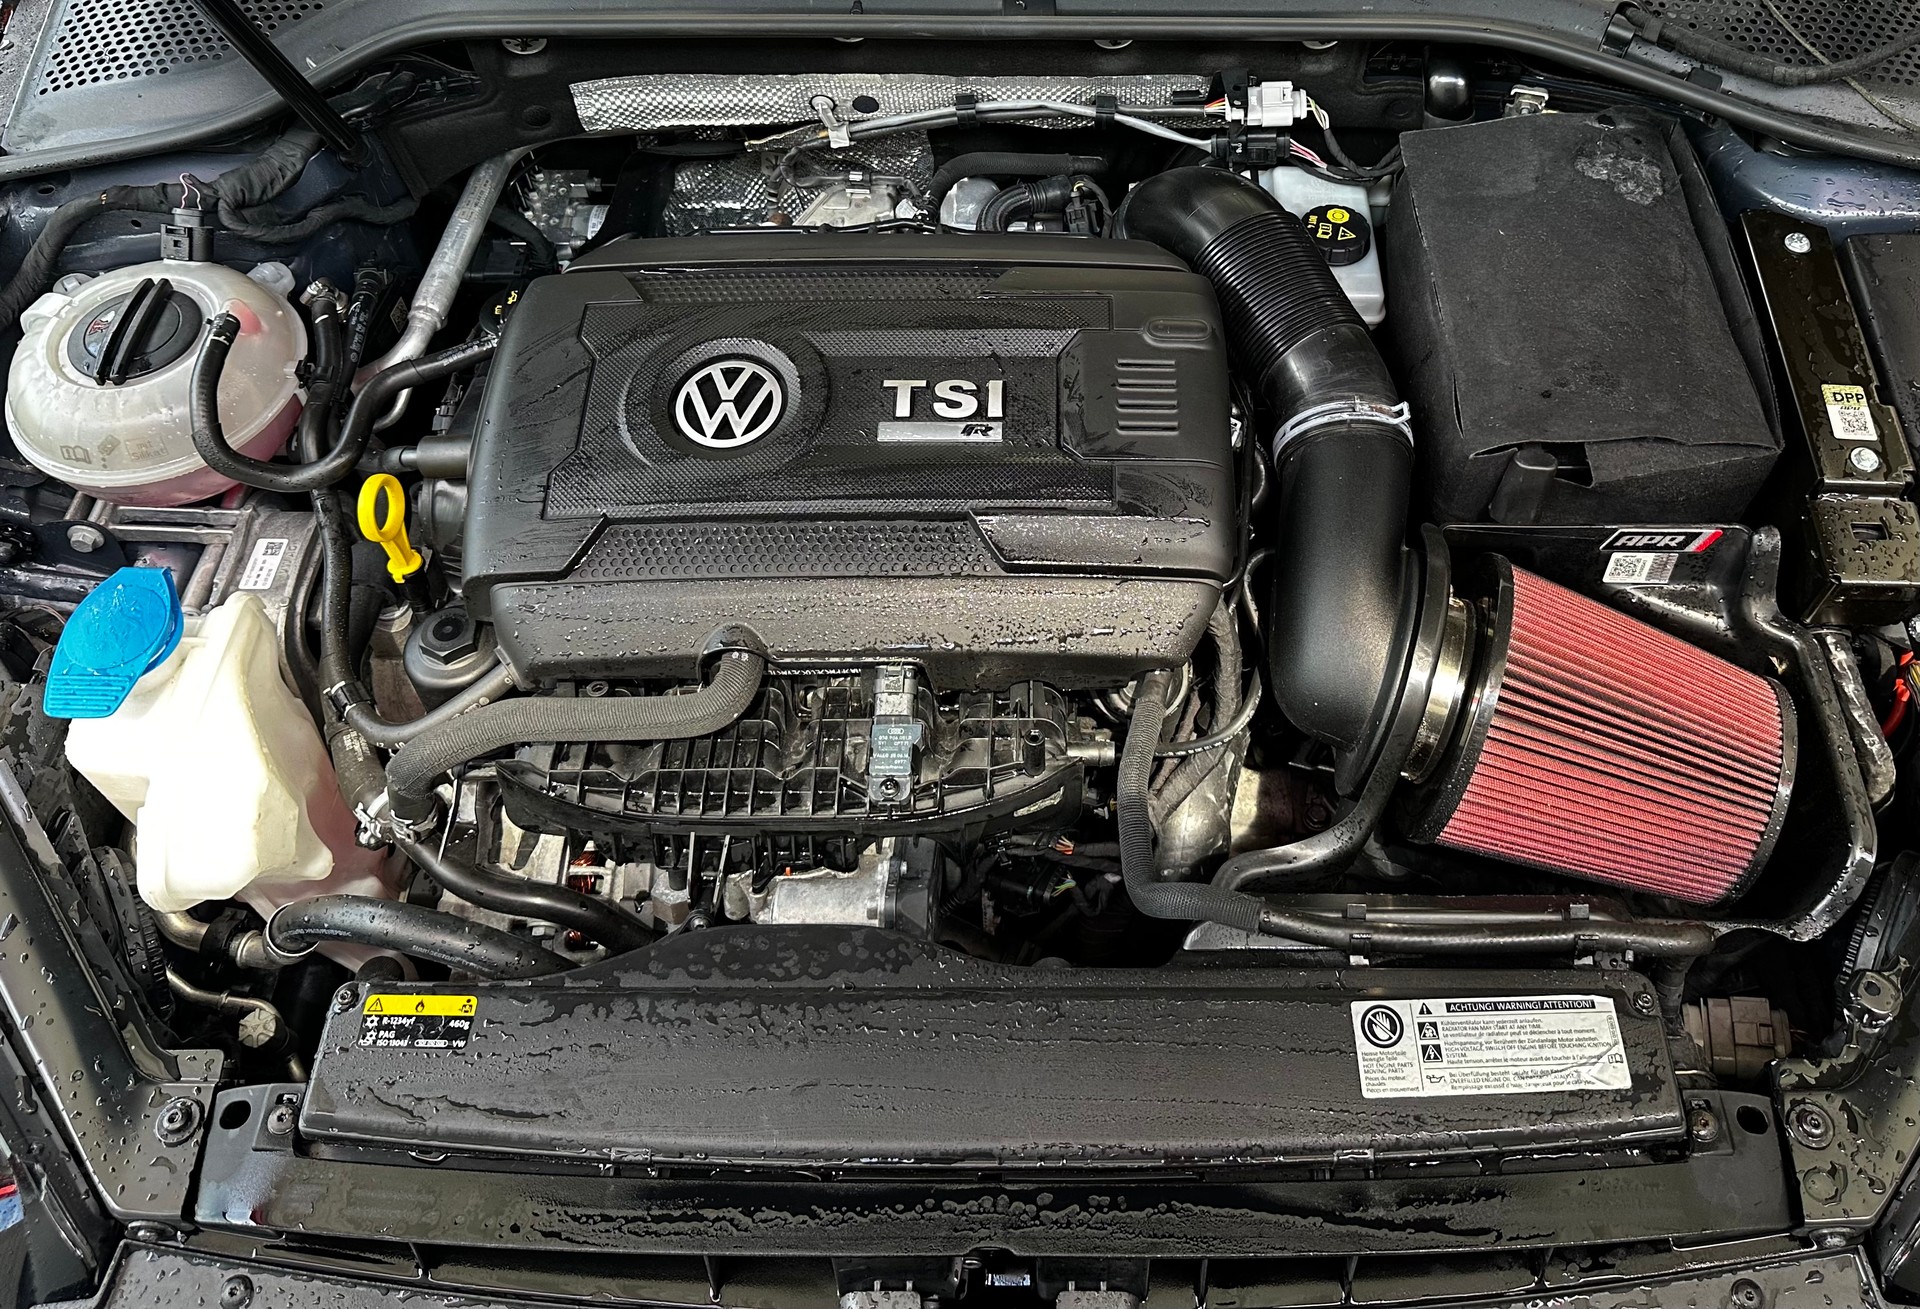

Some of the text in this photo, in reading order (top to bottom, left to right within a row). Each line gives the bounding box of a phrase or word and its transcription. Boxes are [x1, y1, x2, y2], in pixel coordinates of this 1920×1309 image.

[883, 380, 1003, 418] TSI
[1832, 392, 1864, 403] DPP
[1613, 535, 1686, 547] APR
[1450, 1000, 1592, 1012] ACHTUNG! WARNING! ATTENTION!
[382, 1016, 416, 1027] R-1234yf
[448, 1020, 470, 1030] 460g
[378, 1030, 396, 1039] PAG
